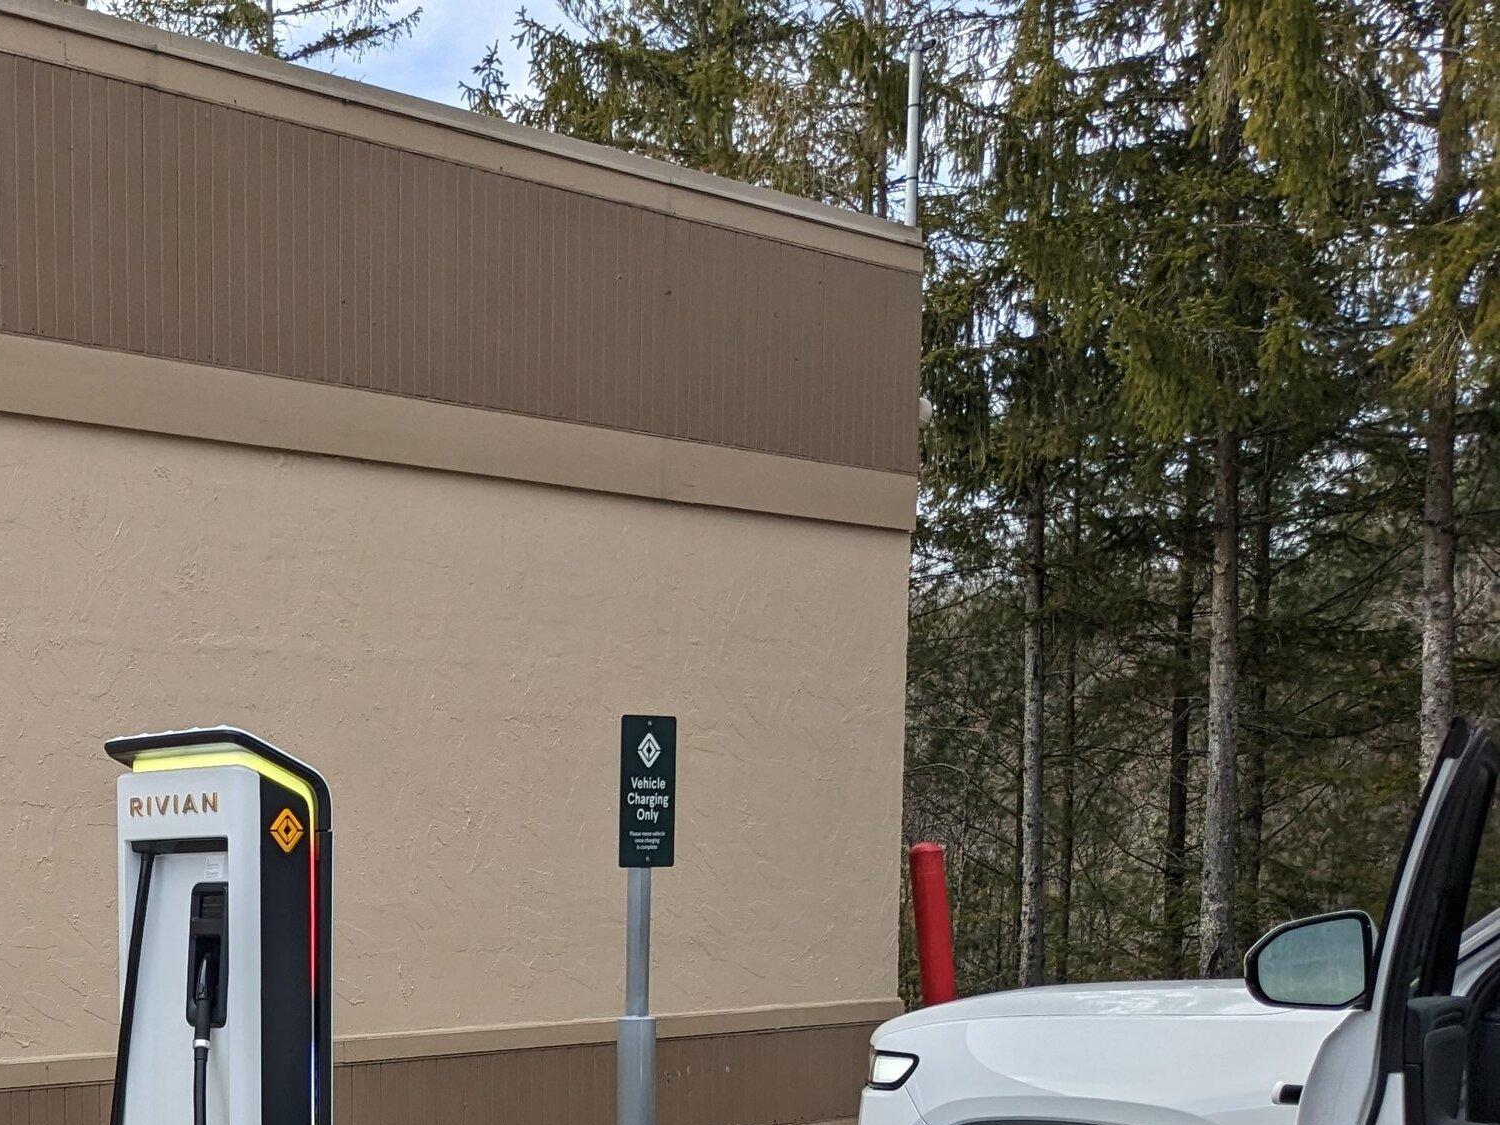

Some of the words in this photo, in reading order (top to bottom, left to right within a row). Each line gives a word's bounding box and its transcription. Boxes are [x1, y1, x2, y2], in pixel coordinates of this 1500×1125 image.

[631, 776, 666, 789] Vehicle
[129, 791, 219, 818] RIVIAN
[627, 792, 669, 808] Charging
[636, 808, 659, 823] Only
